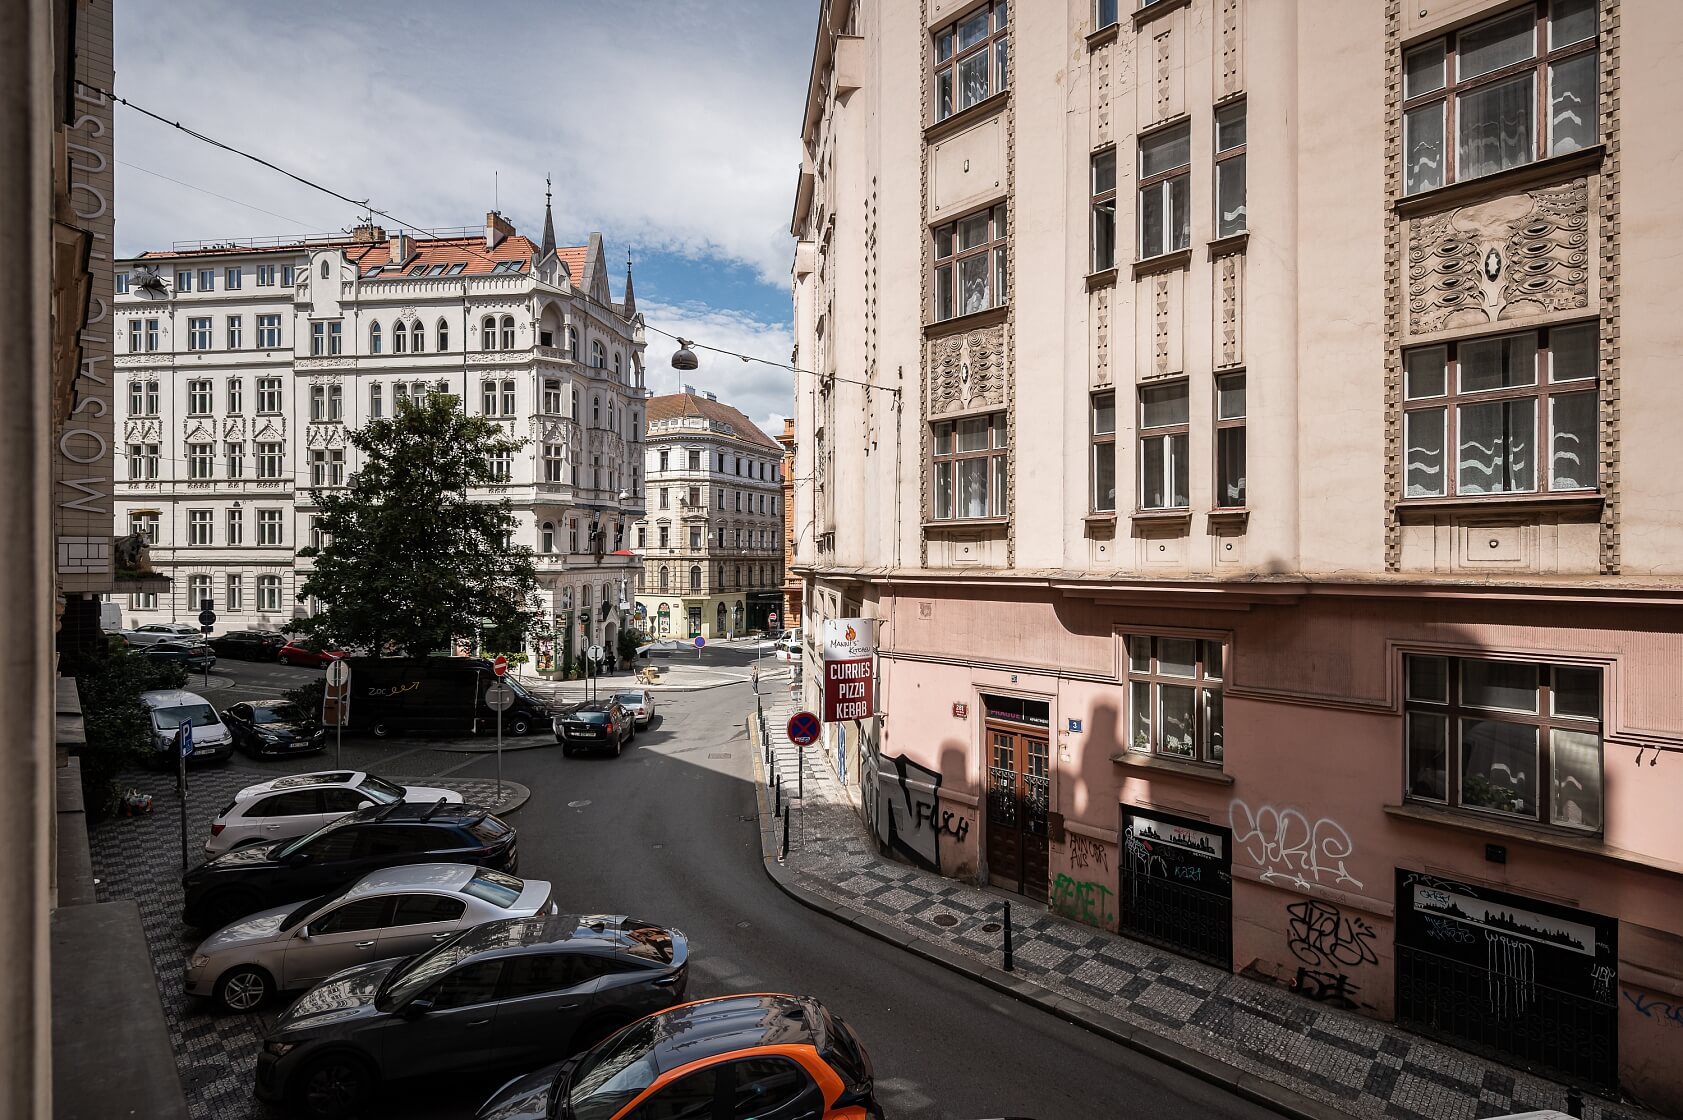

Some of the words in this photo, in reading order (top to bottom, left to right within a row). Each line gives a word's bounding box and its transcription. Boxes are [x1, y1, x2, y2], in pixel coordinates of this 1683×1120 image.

[830, 662, 870, 680] CURRIES
[839, 682, 865, 699] PIZZA
[836, 701, 867, 719] KEBAB
[1072, 721, 1078, 729] 3
[183, 724, 190, 746] P
